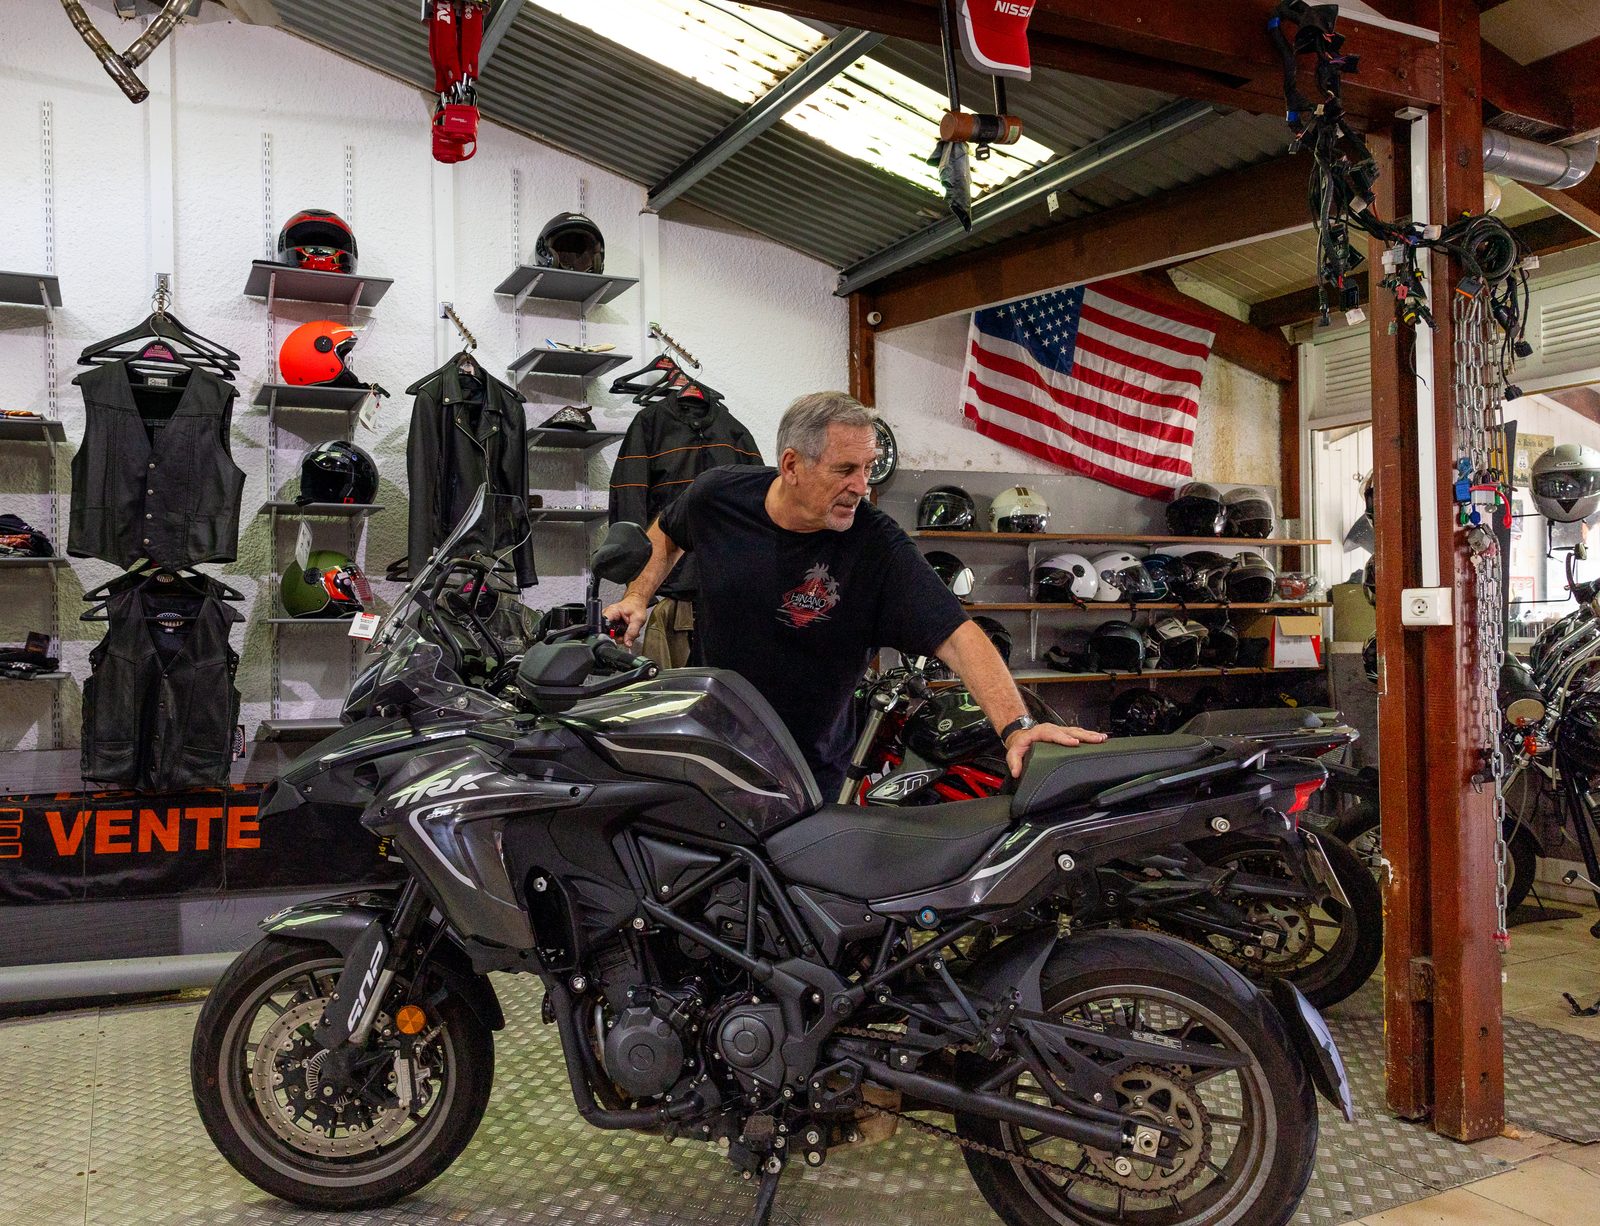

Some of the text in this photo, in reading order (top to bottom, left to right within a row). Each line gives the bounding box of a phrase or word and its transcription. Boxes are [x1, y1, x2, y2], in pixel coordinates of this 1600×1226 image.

[791, 593, 827, 608] HINANO
[388, 761, 498, 809] TRK
[45, 806, 261, 857] VENTE
